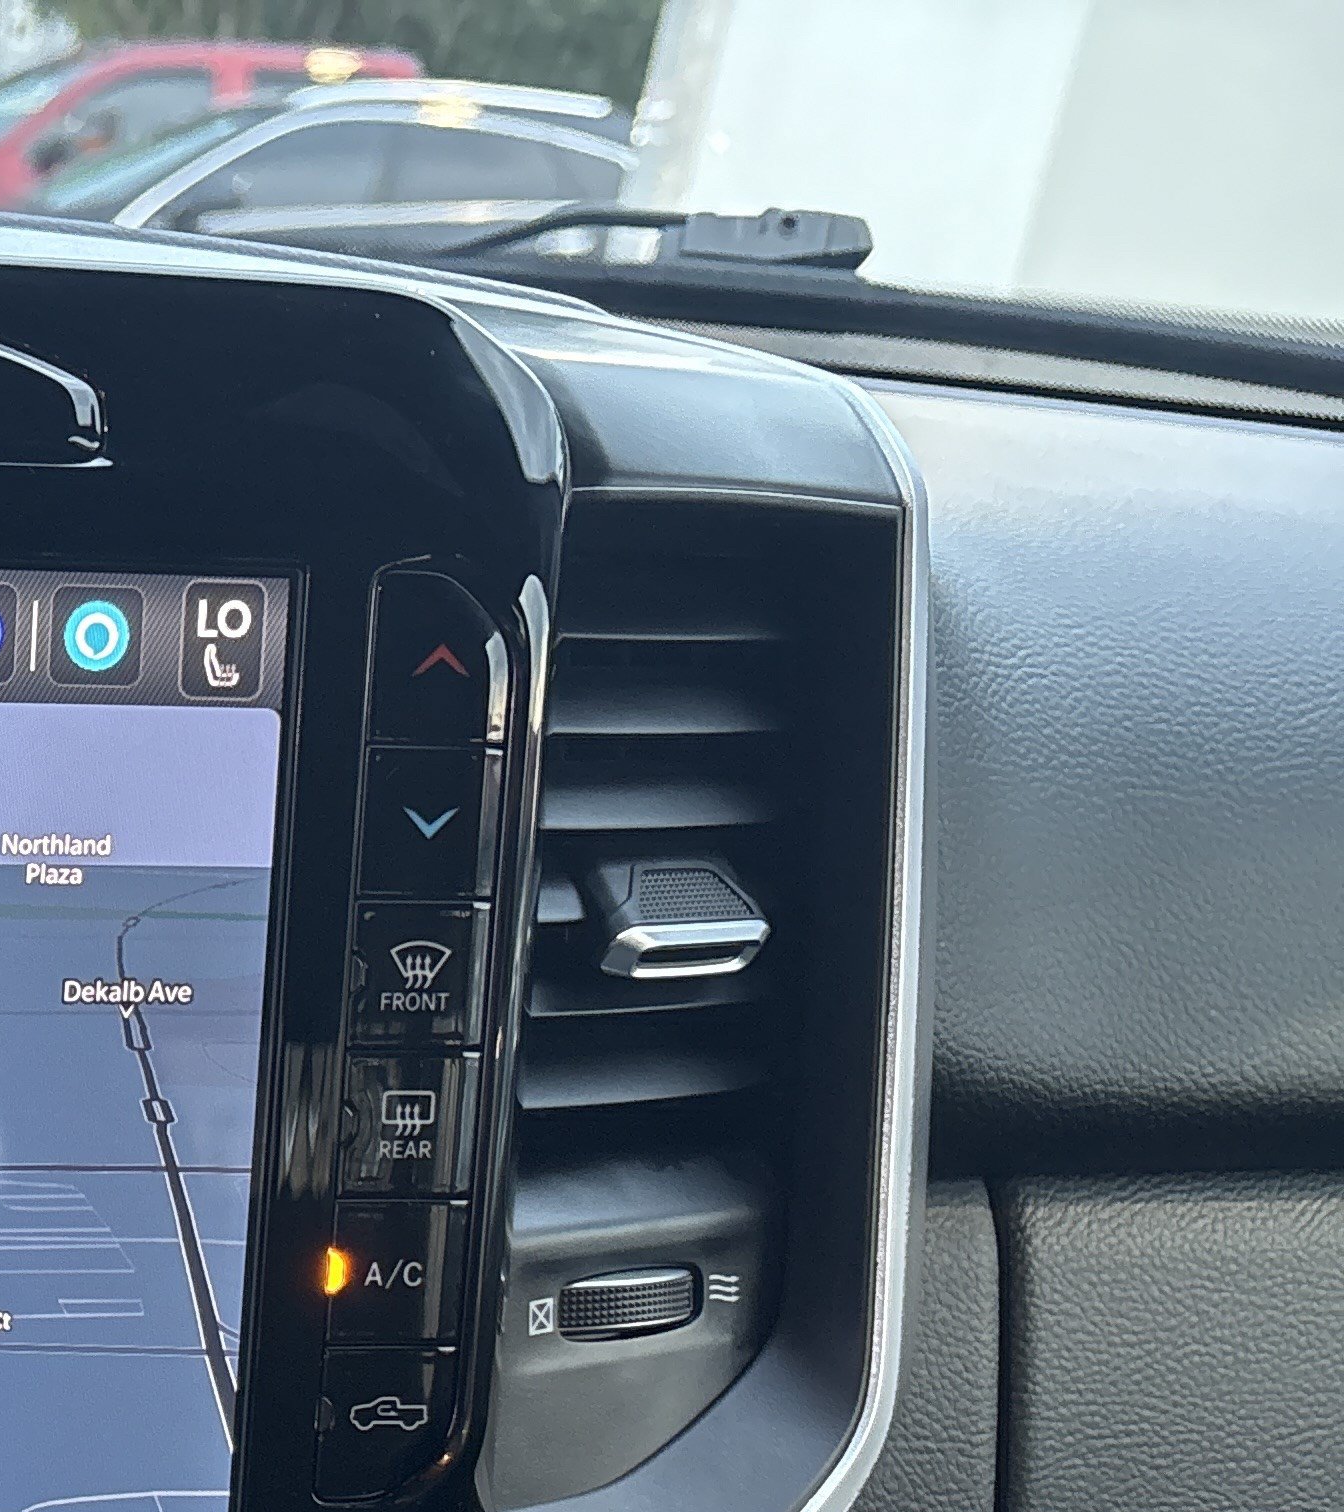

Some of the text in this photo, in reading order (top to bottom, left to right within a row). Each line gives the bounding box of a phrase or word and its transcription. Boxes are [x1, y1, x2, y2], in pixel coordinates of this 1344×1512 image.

[196, 599, 253, 639] LO
[0, 833, 112, 856] Northland
[25, 863, 84, 885] Plaza
[62, 980, 193, 1004] Dekalb Ave
[380, 992, 450, 1012] FRONT
[379, 1140, 432, 1160] REAR
[364, 1259, 423, 1289] A/C
